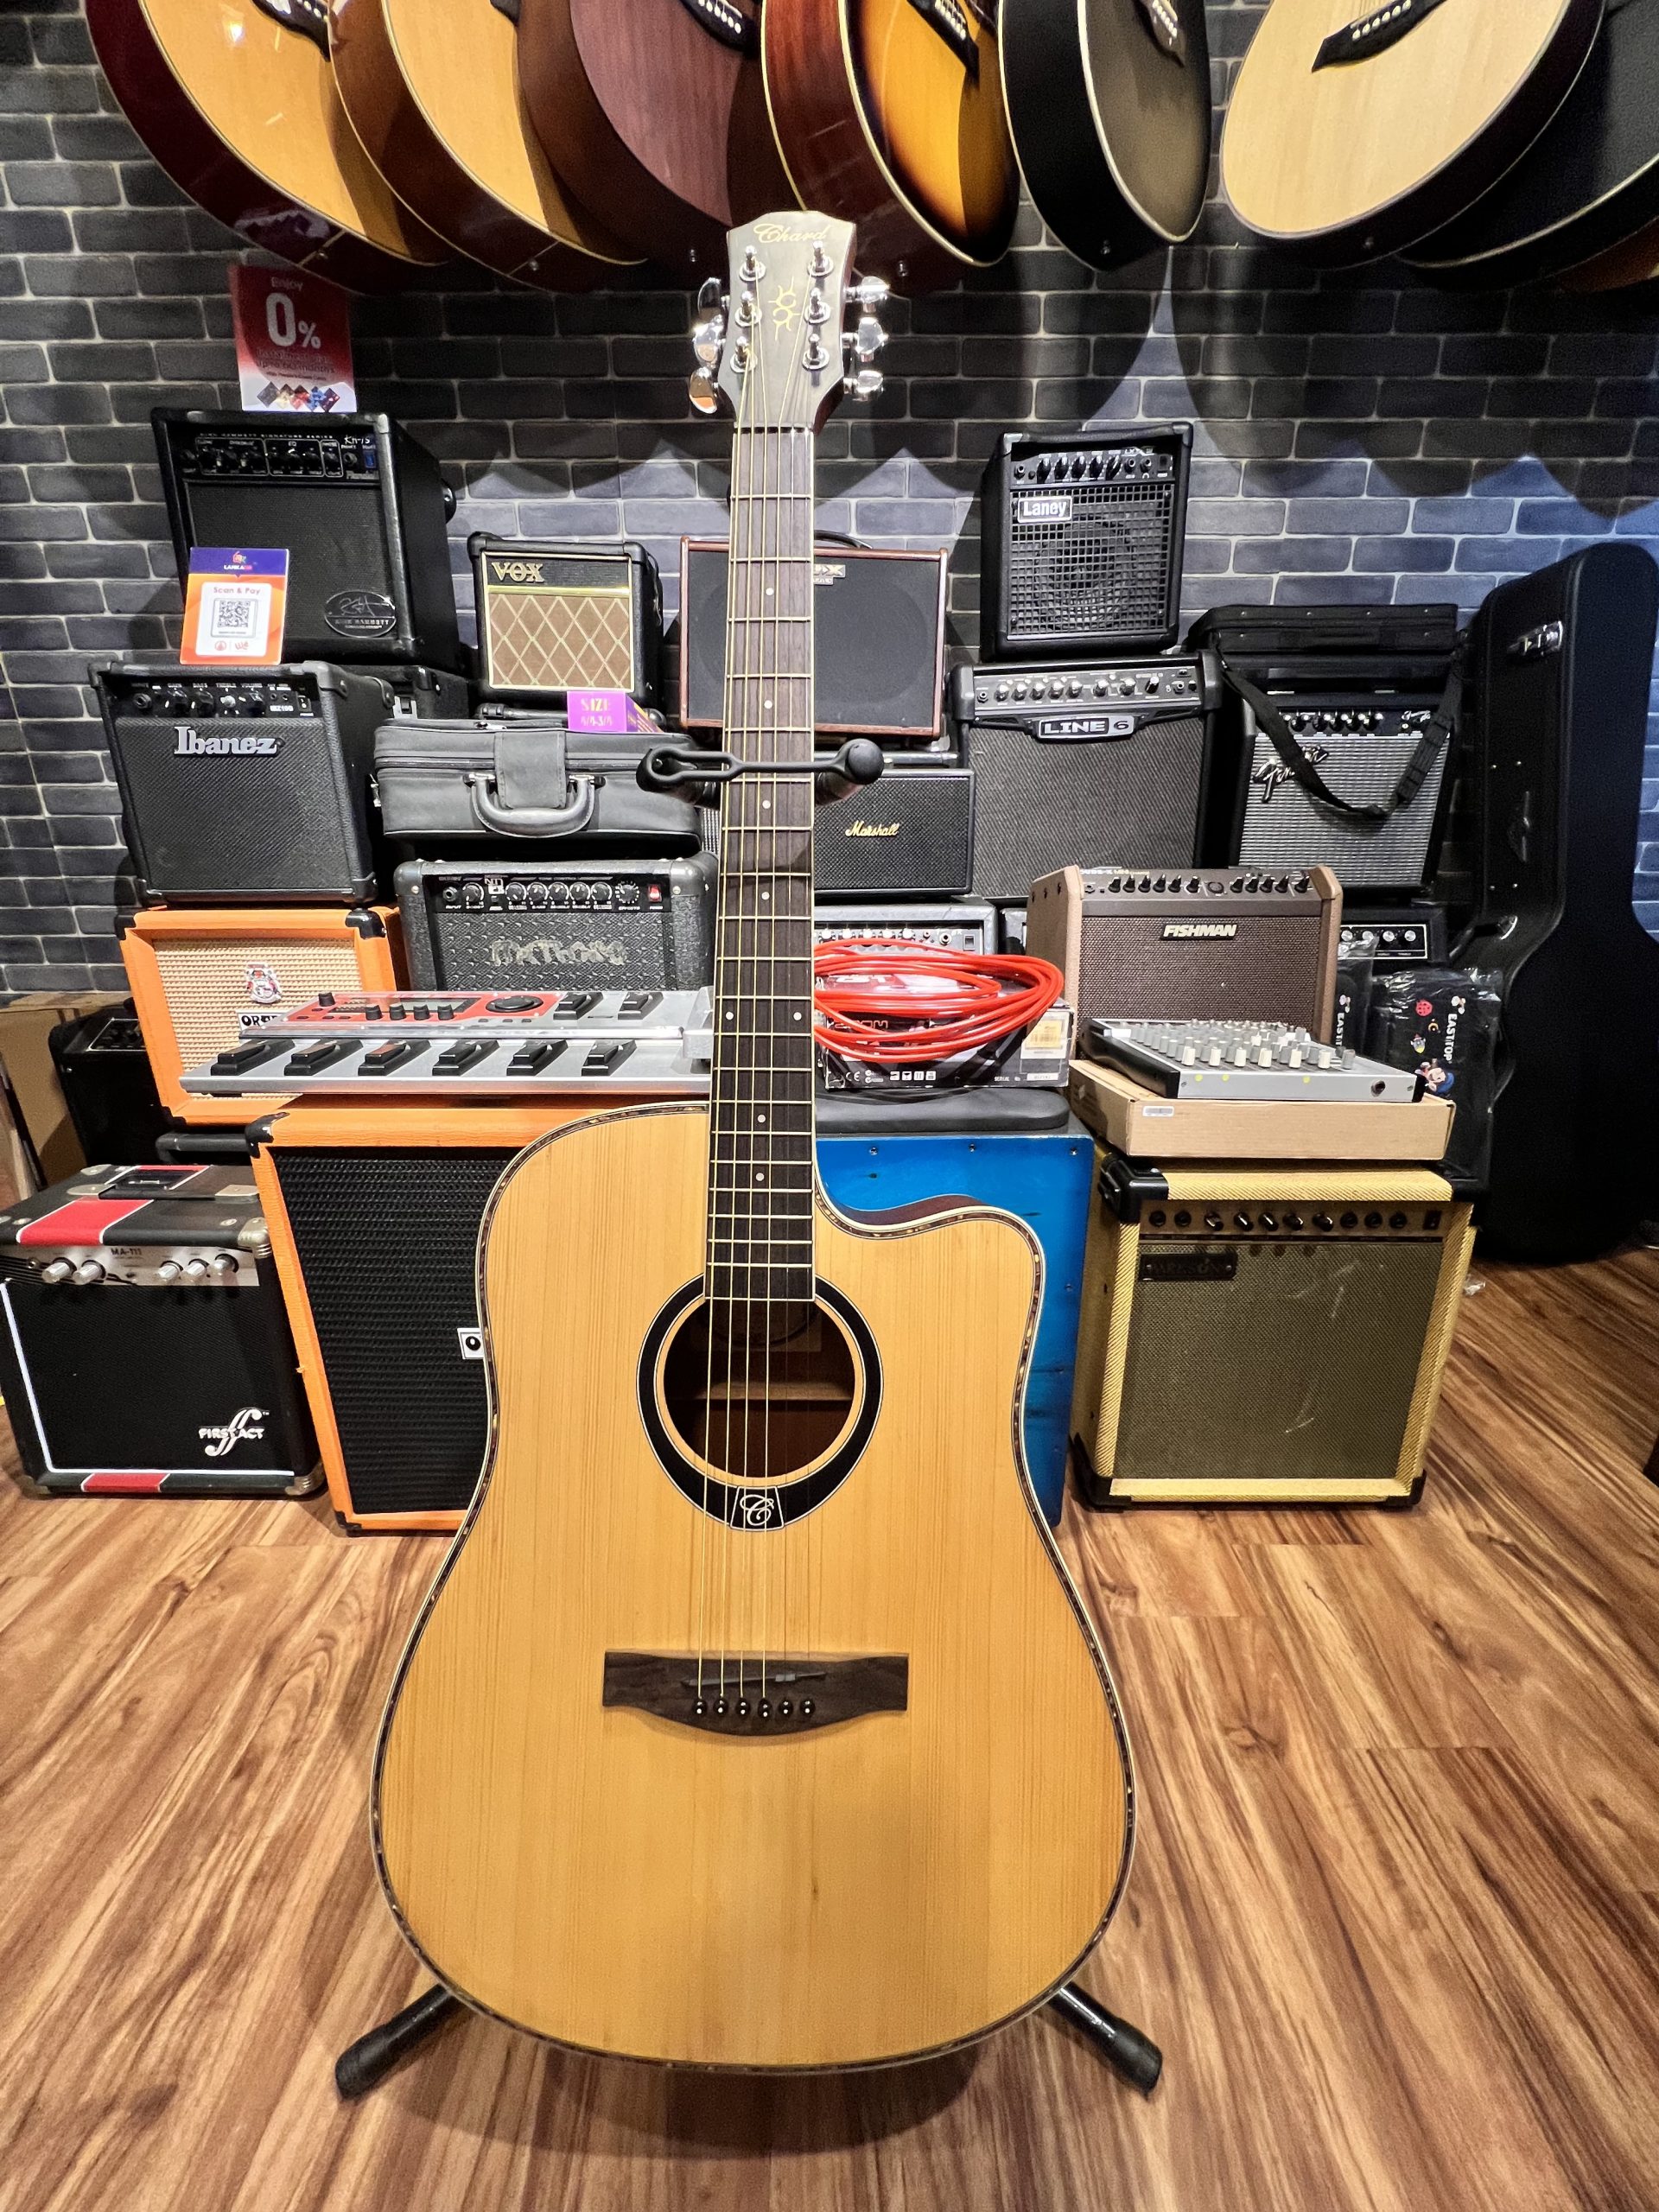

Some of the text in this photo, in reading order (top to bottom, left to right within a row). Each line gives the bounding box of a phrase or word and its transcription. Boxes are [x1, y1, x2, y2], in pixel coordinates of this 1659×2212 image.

[753, 223, 831, 244] Chard
[266, 292, 321, 349] 0%
[1023, 501, 1067, 517] Laney
[492, 562, 545, 582] VOX
[1044, 720, 1129, 734] LINE 6
[174, 726, 277, 755] Ibanez
[845, 820, 899, 836] Marshall
[1163, 924, 1237, 938] FISHMAN
[199, 1427, 264, 1440] FIRST ACT
